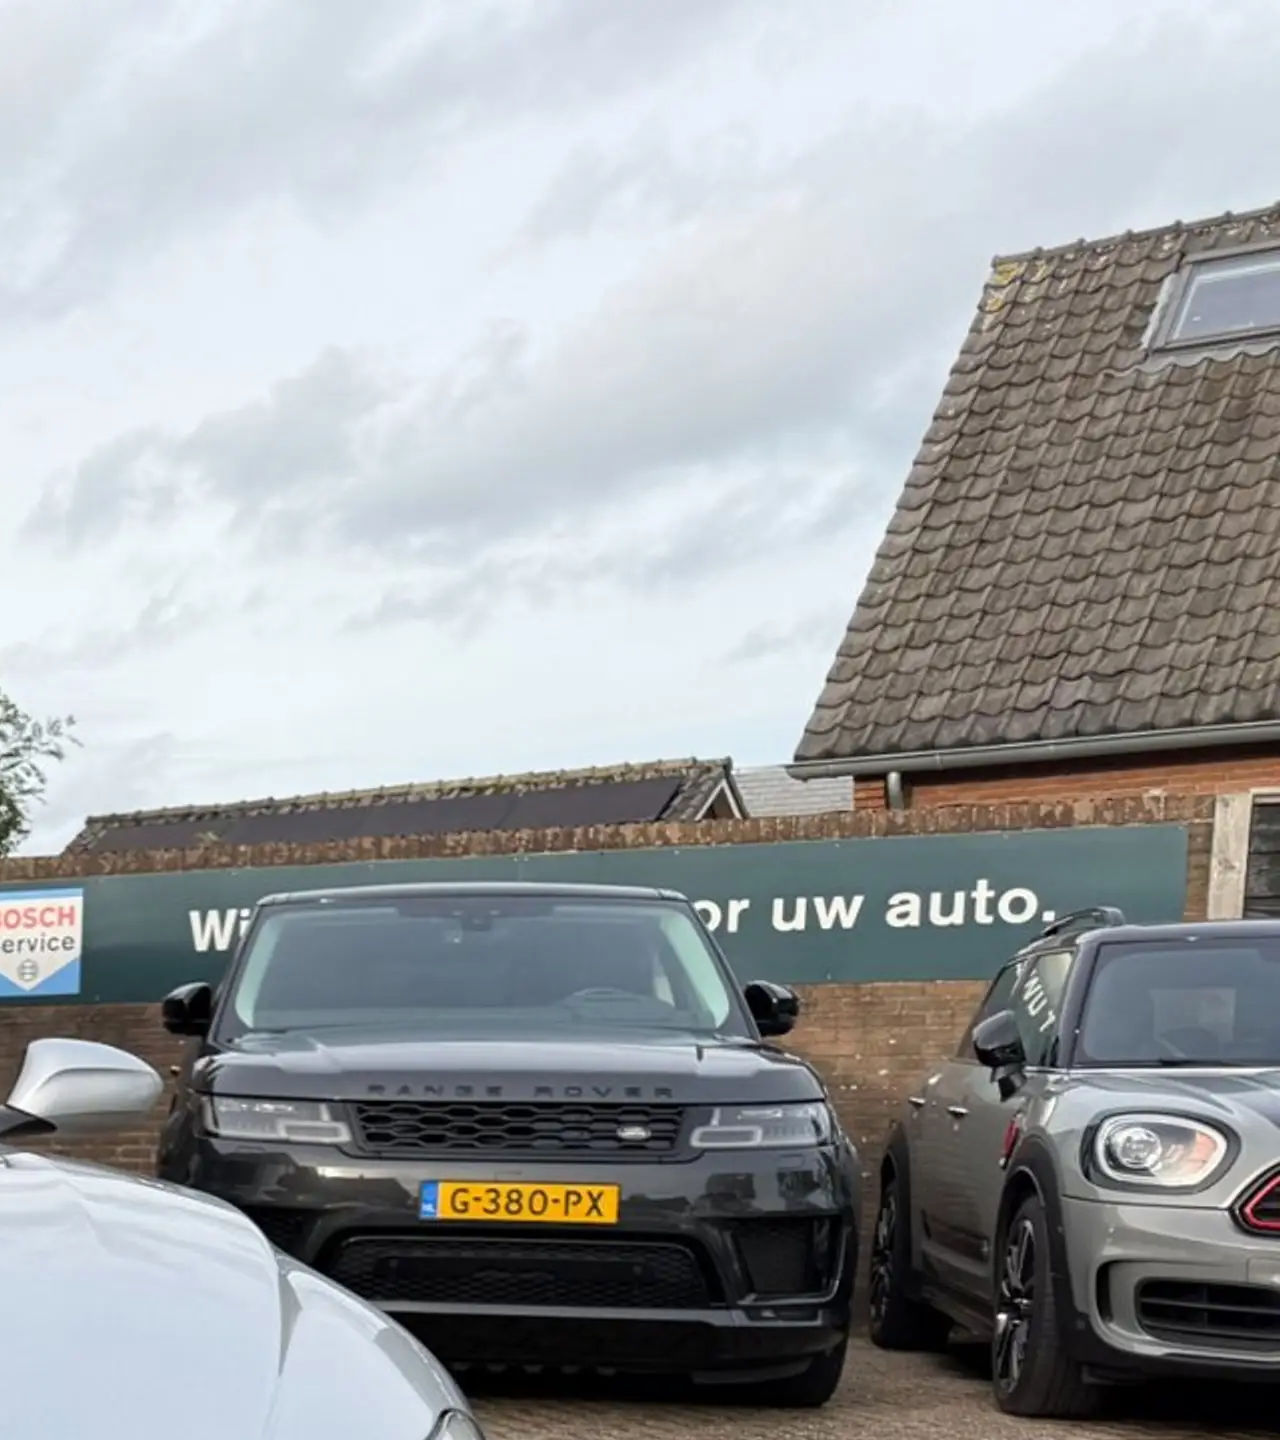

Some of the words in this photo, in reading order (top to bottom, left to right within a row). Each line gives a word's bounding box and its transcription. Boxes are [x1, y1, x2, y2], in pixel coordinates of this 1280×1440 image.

[772, 895, 865, 931] uw
[886, 879, 1056, 927] auto.
[367, 1084, 503, 1097] RANGE
[534, 1085, 673, 1099] ROVER
[450, 1187, 605, 1217] G-380-PX
